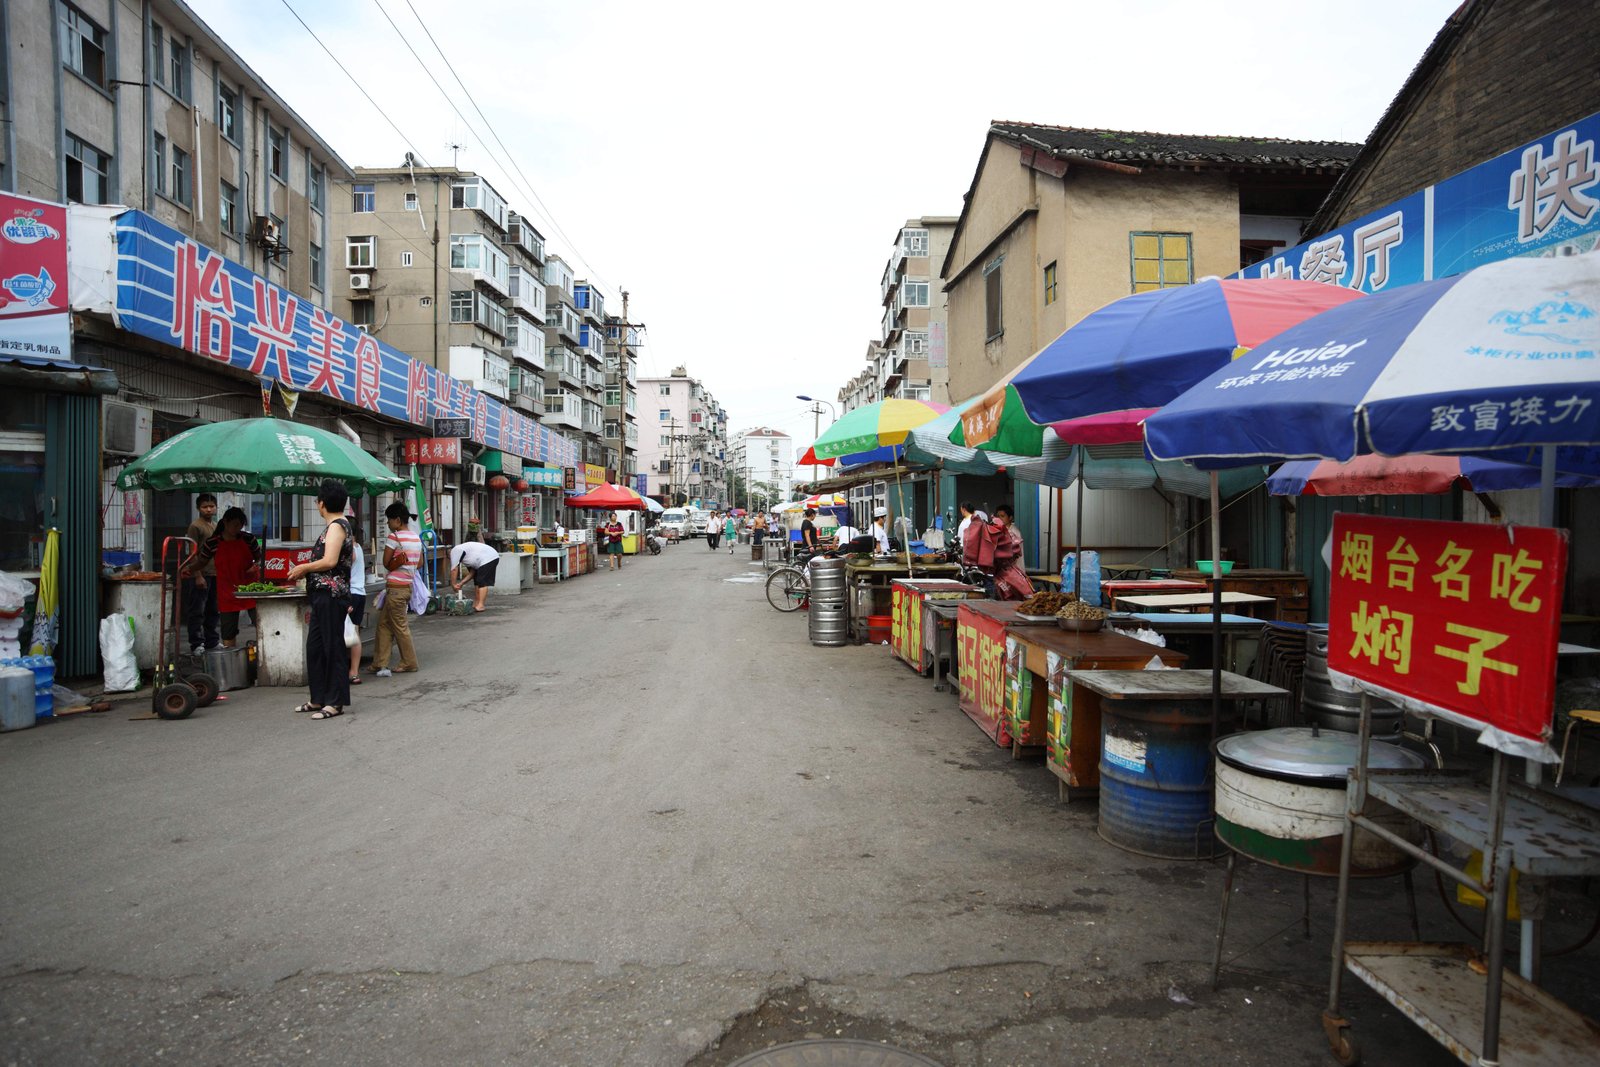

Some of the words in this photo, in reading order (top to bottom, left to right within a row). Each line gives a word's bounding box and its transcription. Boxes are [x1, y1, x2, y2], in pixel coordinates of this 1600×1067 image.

[1508, 130, 1600, 243] 快
[6, 226, 51, 238] 优酸乳
[171, 238, 383, 413] 怡兴美食
[1250, 339, 1368, 371] Haier
[1215, 361, 1356, 389] 环保节能冷柜
[438, 421, 467, 436] 炒菜
[1430, 395, 1593, 431] 致富接力
[208, 473, 247, 485] SNOW
[1339, 531, 1543, 613] 烟台名吃
[1348, 600, 1519, 696] 焖子
